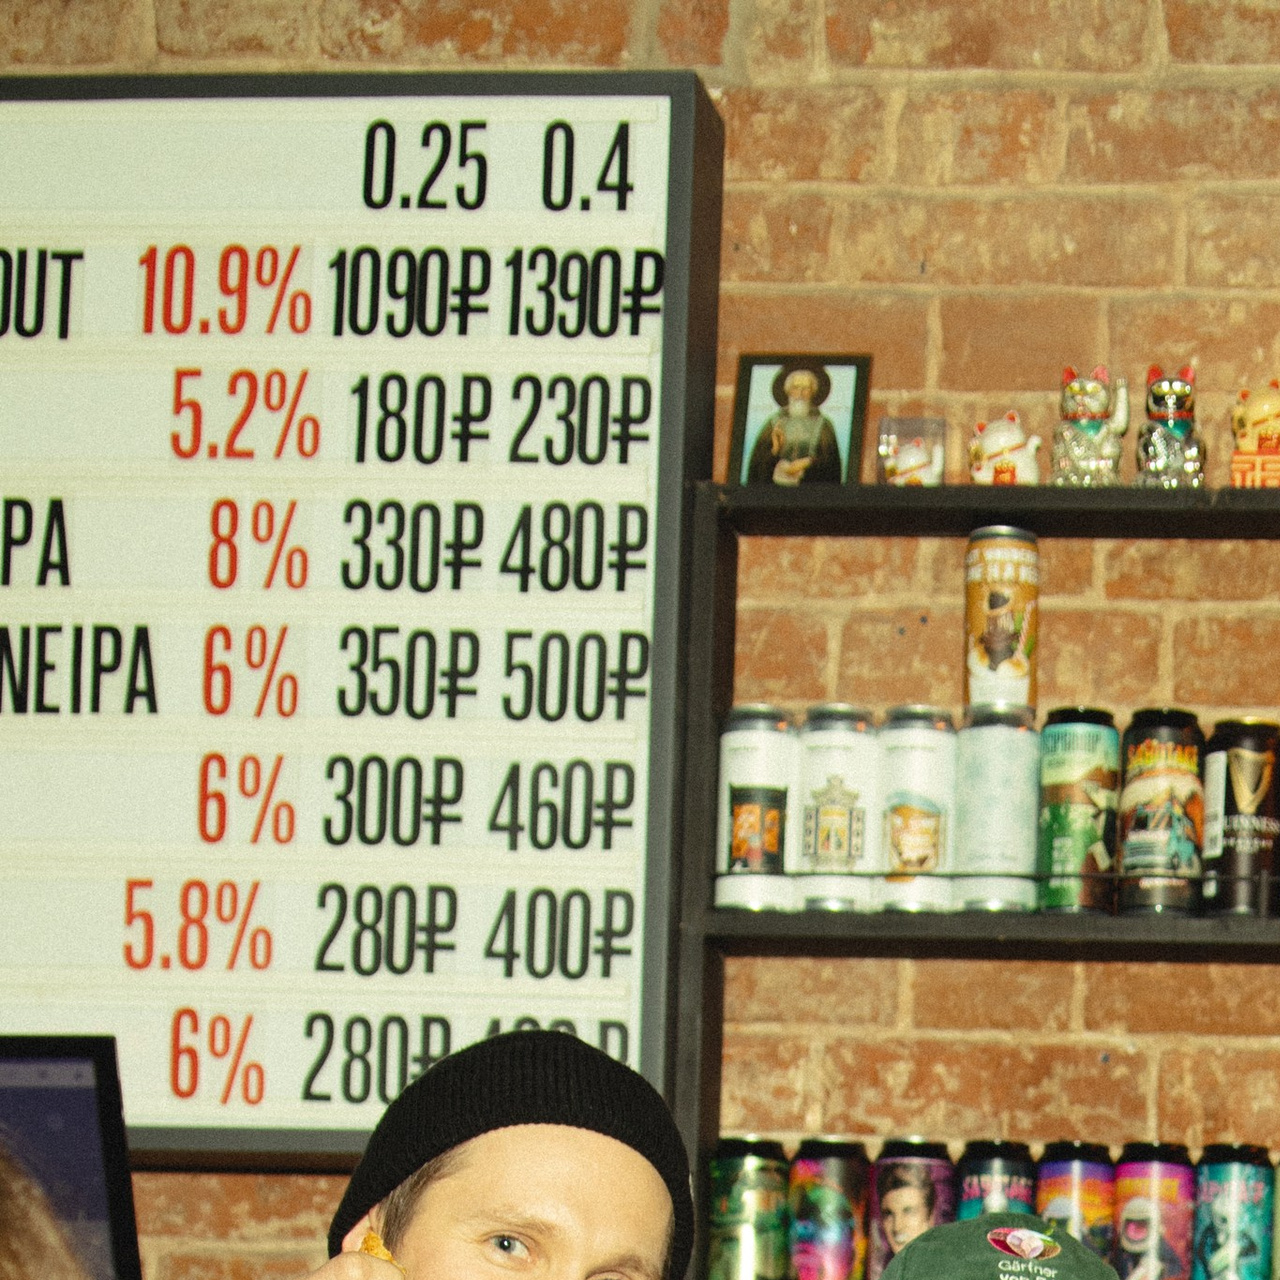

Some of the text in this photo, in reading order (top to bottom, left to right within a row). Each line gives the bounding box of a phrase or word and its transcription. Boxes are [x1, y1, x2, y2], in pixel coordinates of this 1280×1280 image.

[362, 118, 634, 211] 0.25 0.4
[138, 243, 311, 335] 10.9%
[329, 244, 491, 338] 1090₽
[505, 246, 665, 338] 1390₽
[170, 367, 652, 466] 5.2% 180₽ 230₽
[0, 496, 648, 593] PA 8% 330₽ 480₽
[0, 623, 651, 722] NEIPA 6% 350₽ 500₽
[198, 751, 635, 851] 6% 300₽ 460₽
[123, 878, 634, 980] 5.8% 280₽ 400₽
[170, 1007, 264, 1105] 6%
[998, 1260, 1058, 1278] Gärtner
